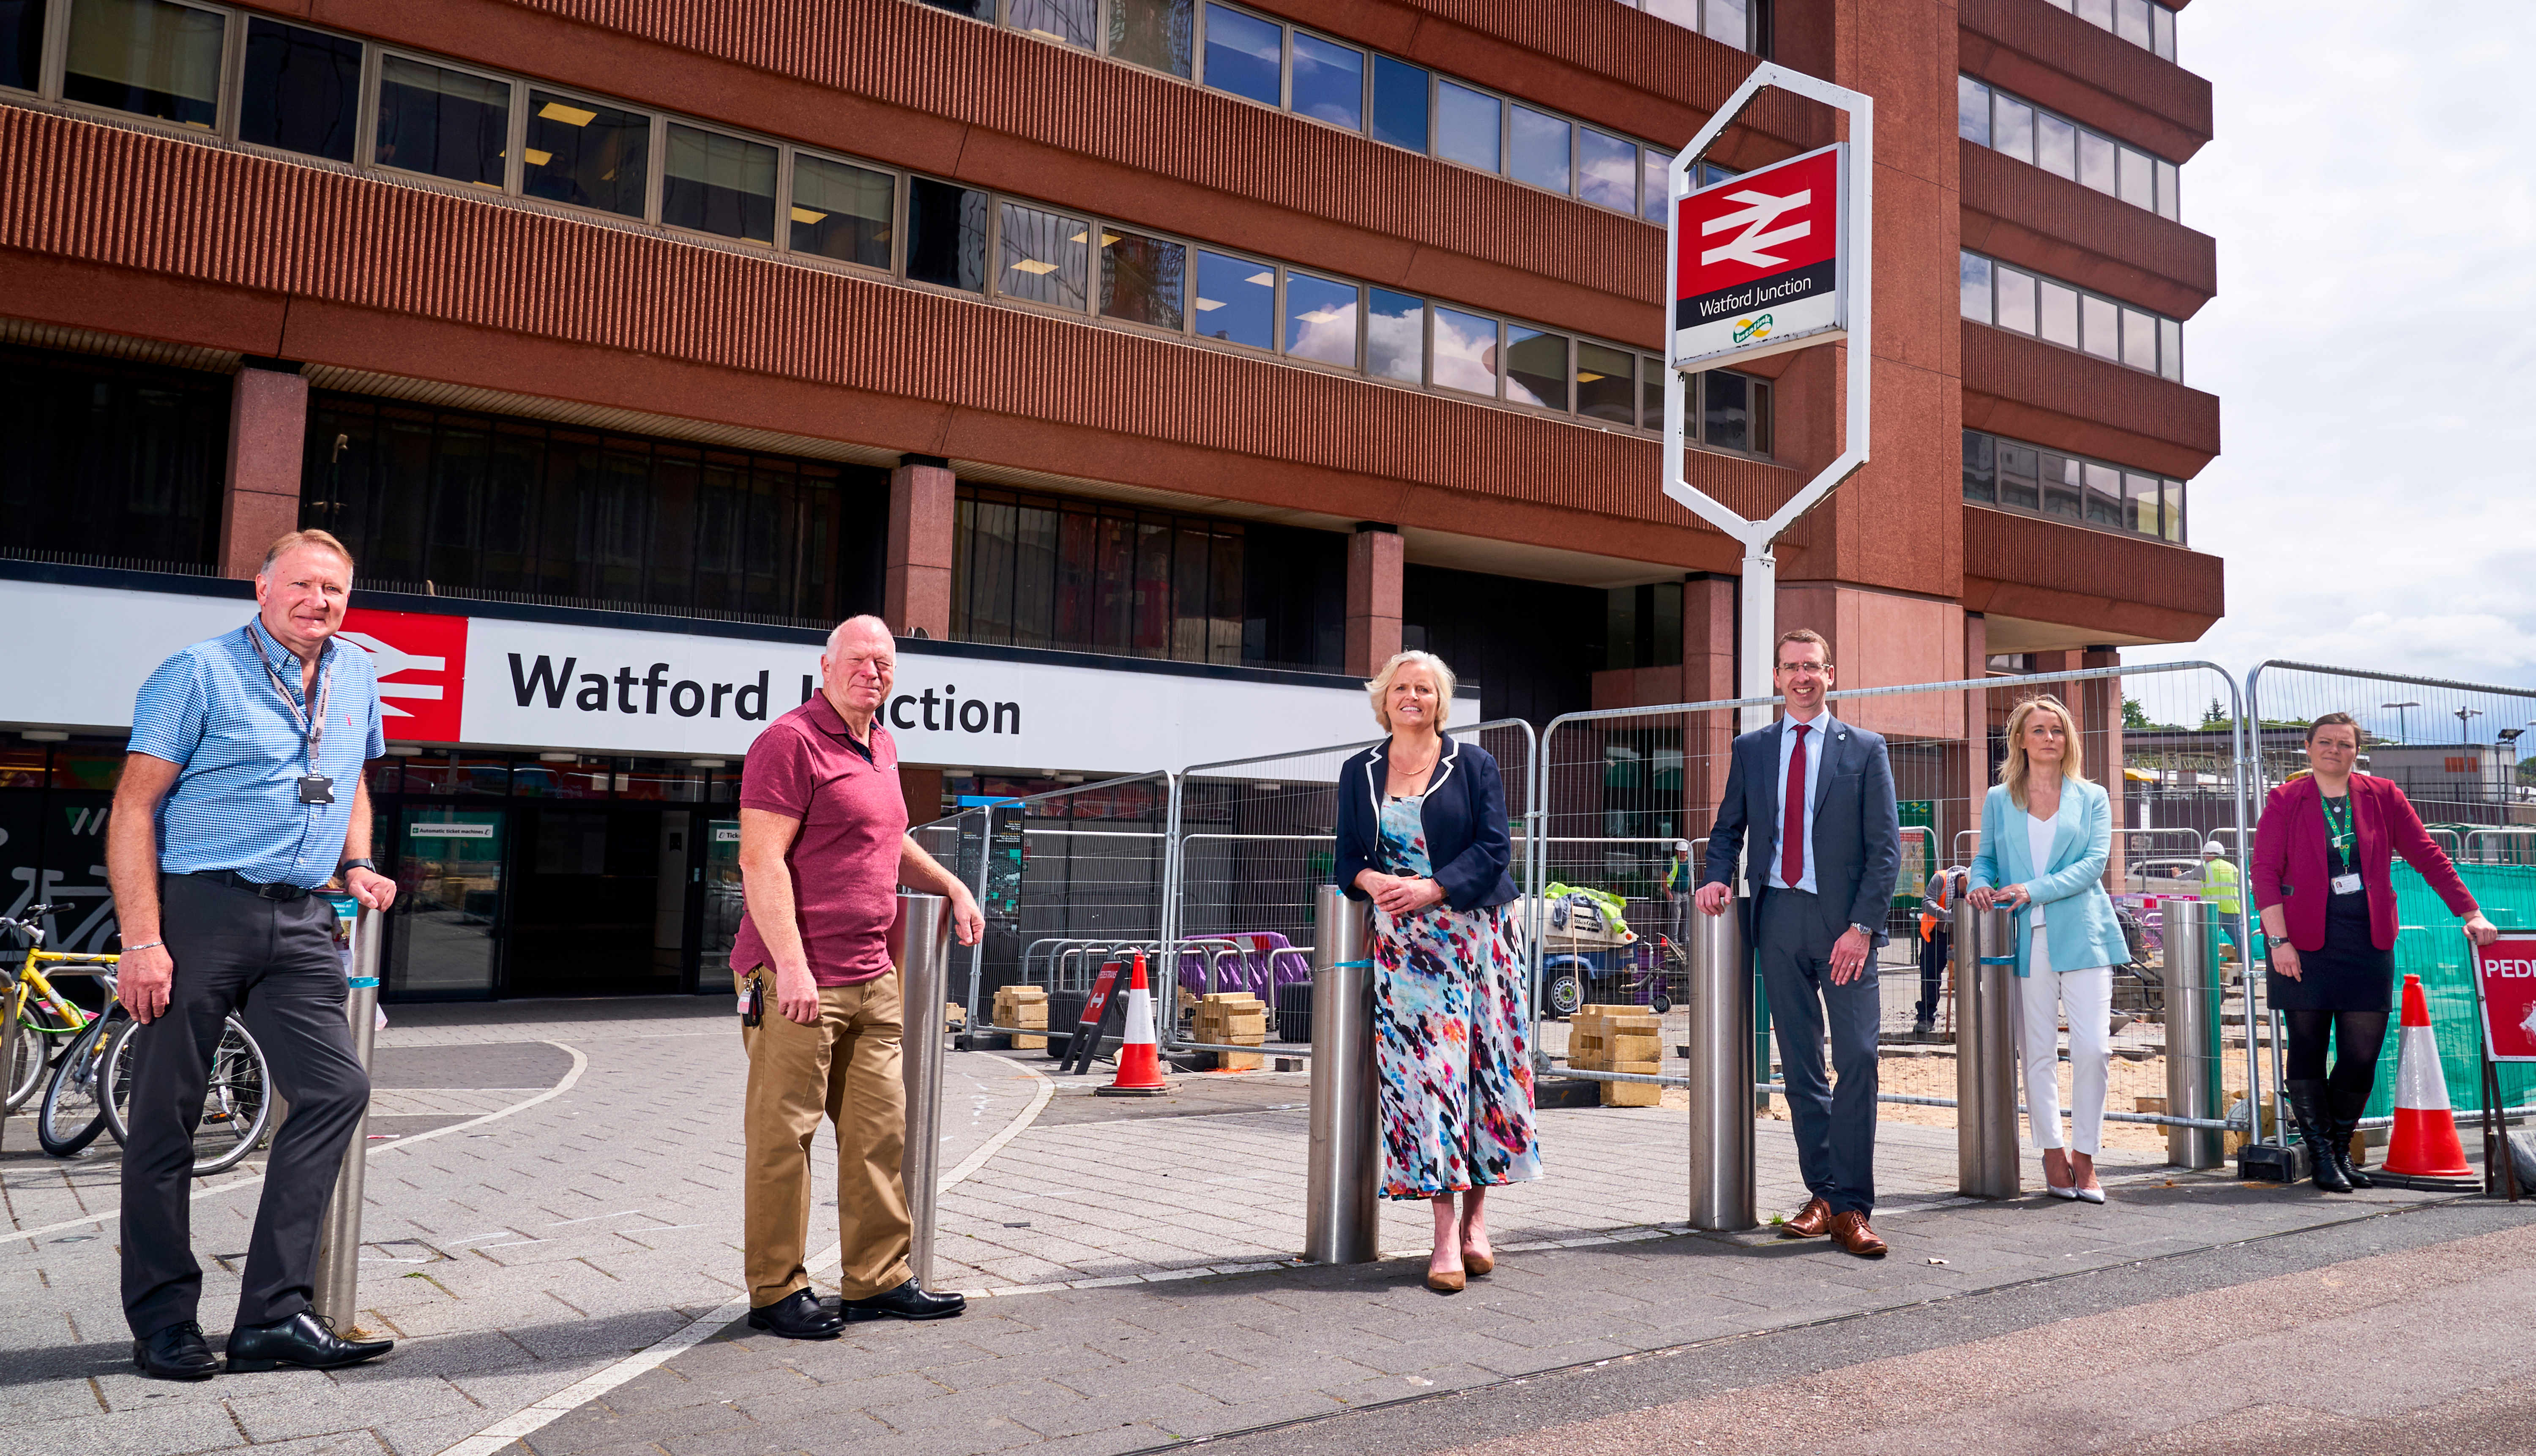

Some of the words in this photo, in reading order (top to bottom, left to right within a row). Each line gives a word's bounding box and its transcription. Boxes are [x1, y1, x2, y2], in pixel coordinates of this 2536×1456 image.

[1700, 289, 1752, 317] Watford
[1754, 277, 1812, 306] Junction
[1736, 314, 1771, 343] Intalink
[508, 653, 769, 721] Watford
[801, 675, 1020, 735] Jction
[2485, 959, 2536, 978] PED
